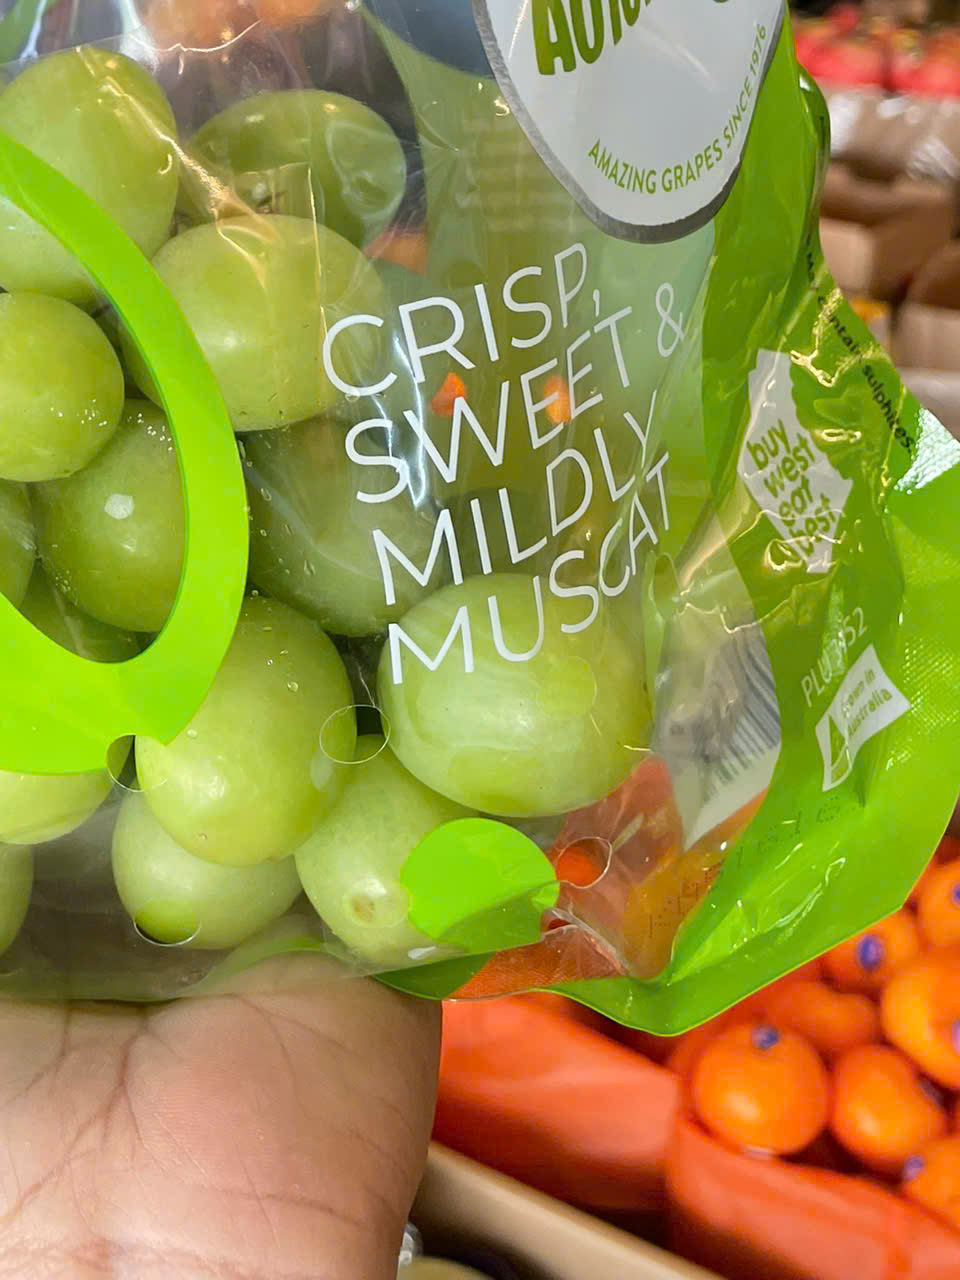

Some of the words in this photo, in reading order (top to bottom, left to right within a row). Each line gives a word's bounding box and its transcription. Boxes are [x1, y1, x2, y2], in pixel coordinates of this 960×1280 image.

[588, 138, 657, 195] AMAZING
[661, 138, 723, 193] GRAPES
[723, 76, 752, 149] SINCE
[749, 23, 767, 77] 1976
[322, 242, 602, 397] CRISP,
[345, 306, 633, 504] SWEET
[654, 281, 685, 358] &
[372, 389, 658, 606] MILDLY
[746, 418, 791, 471] buy
[763, 431, 816, 498] west
[387, 451, 670, 686] MUSCAT
